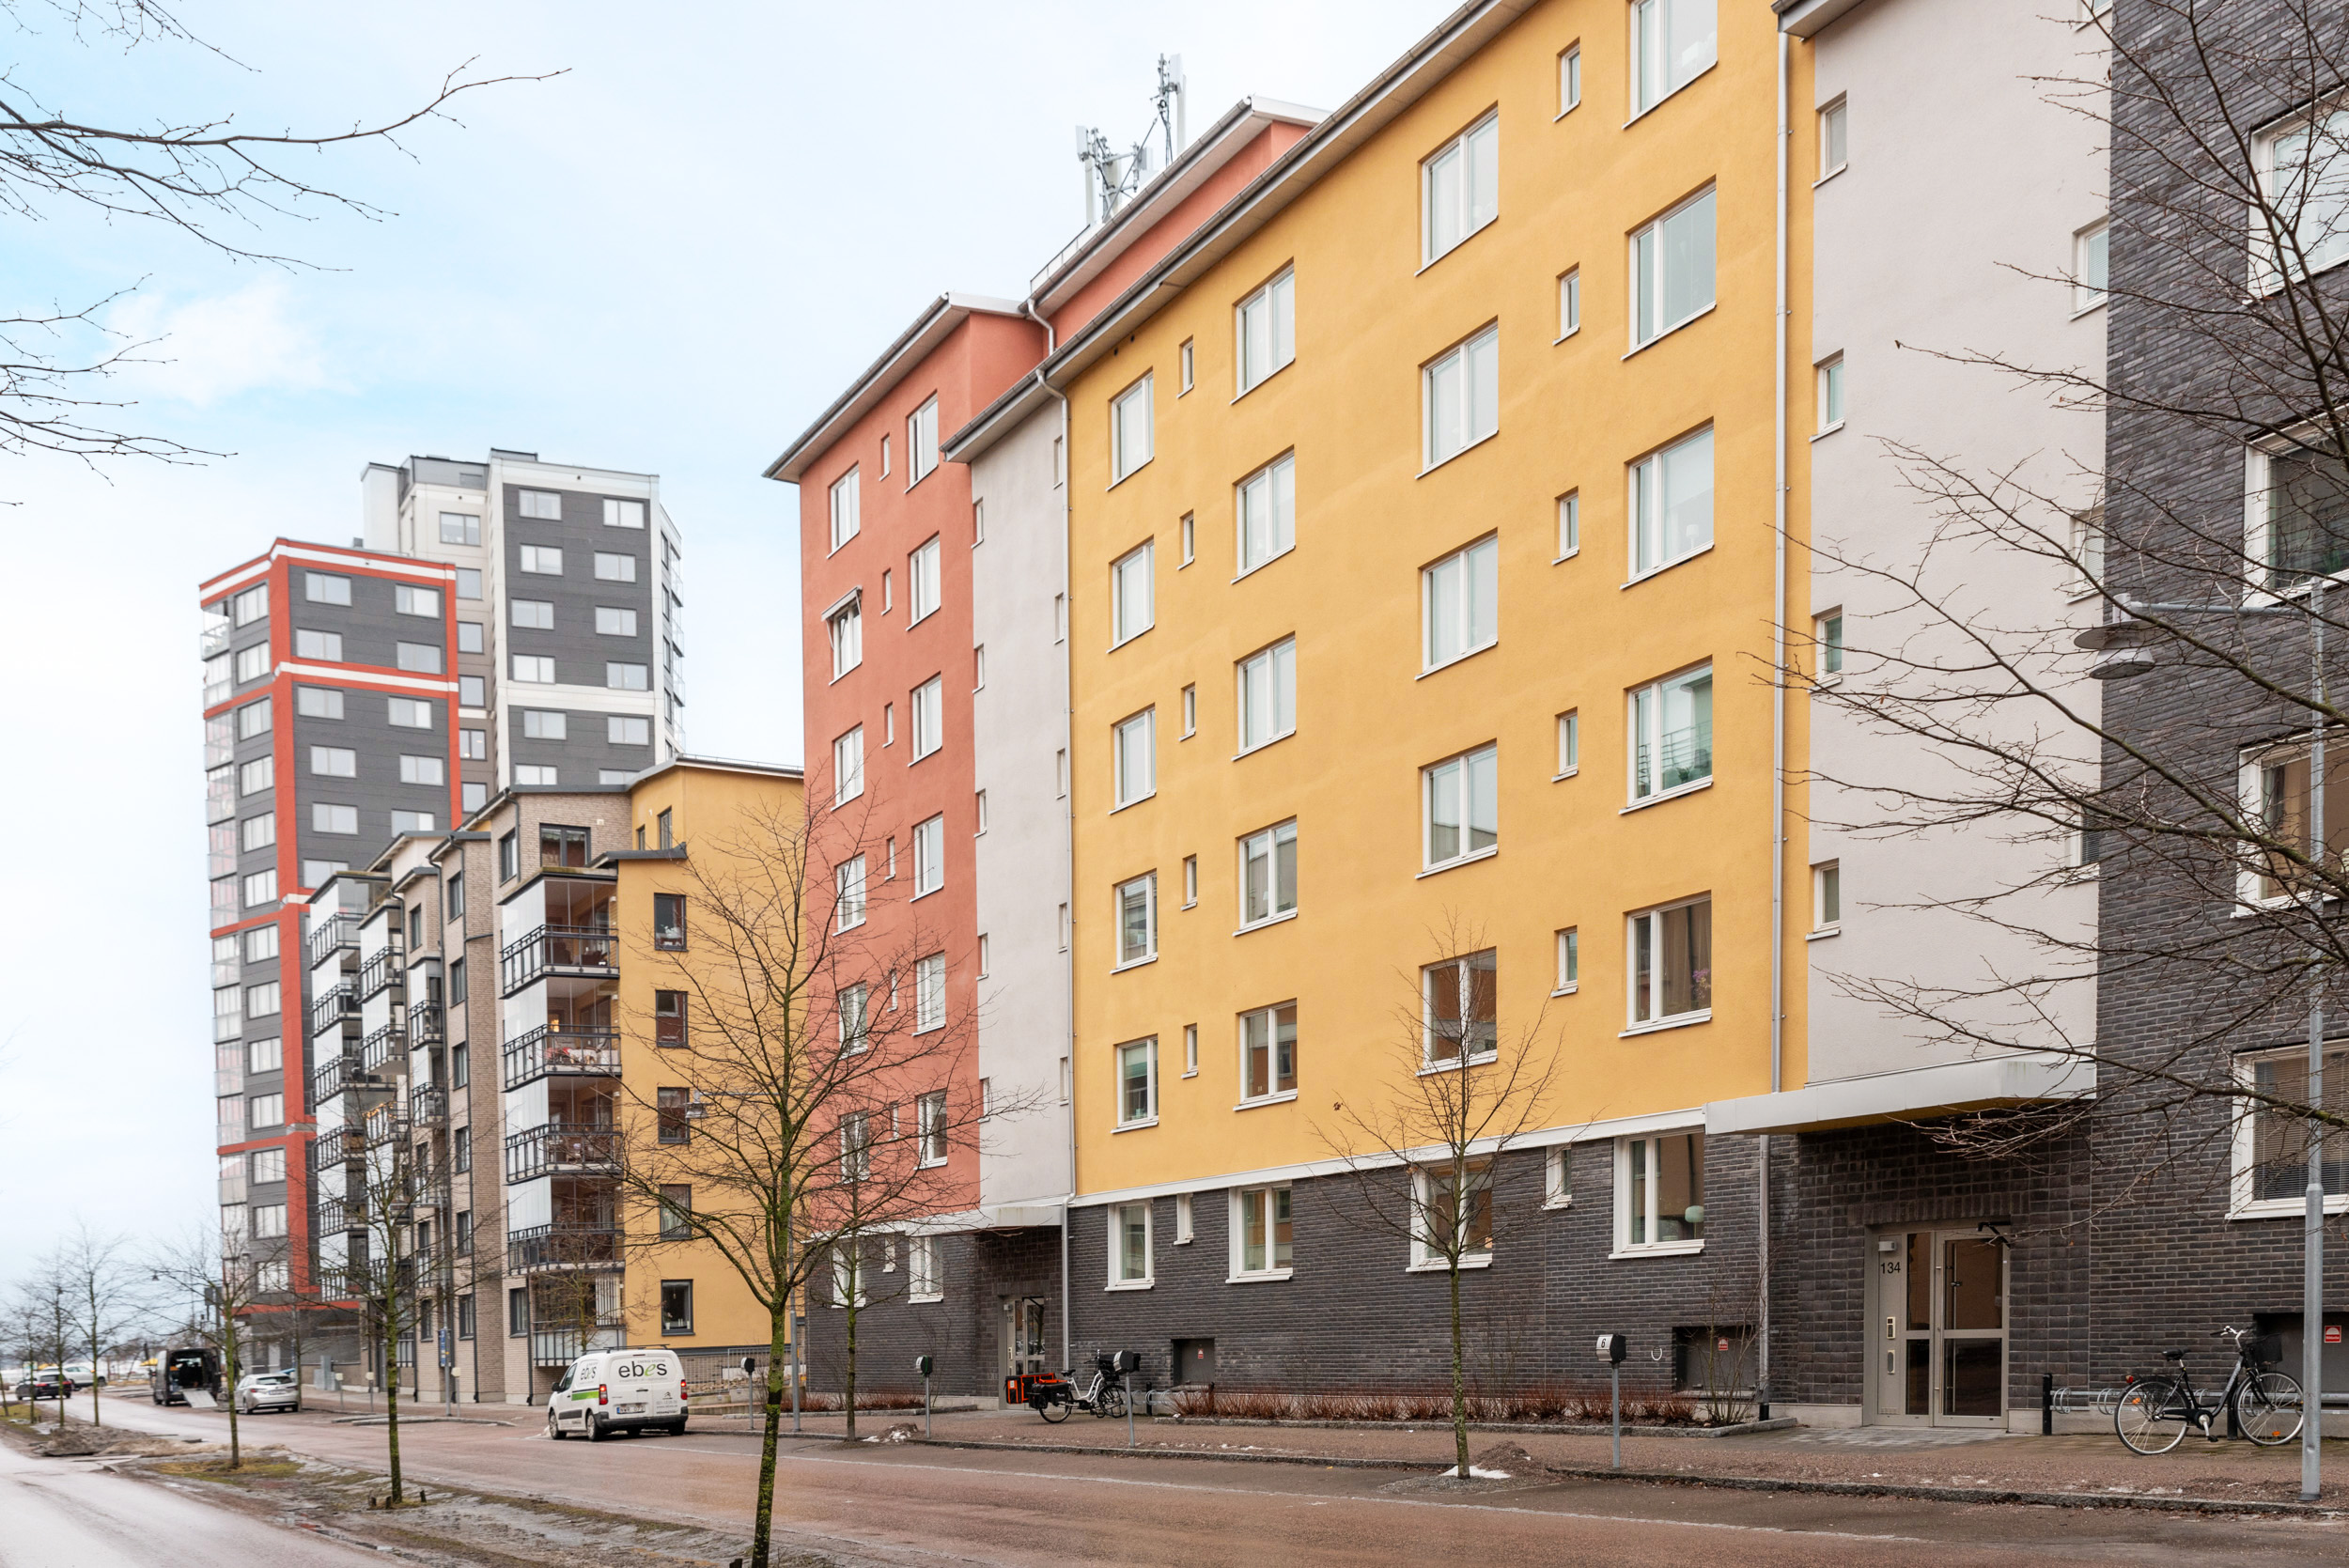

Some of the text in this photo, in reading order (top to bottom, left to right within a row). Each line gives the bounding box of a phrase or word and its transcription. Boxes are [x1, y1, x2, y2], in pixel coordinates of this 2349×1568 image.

[1880, 1262, 1901, 1274] 134
[1600, 1338, 1607, 1348] 6
[618, 1361, 668, 1378] ebes
